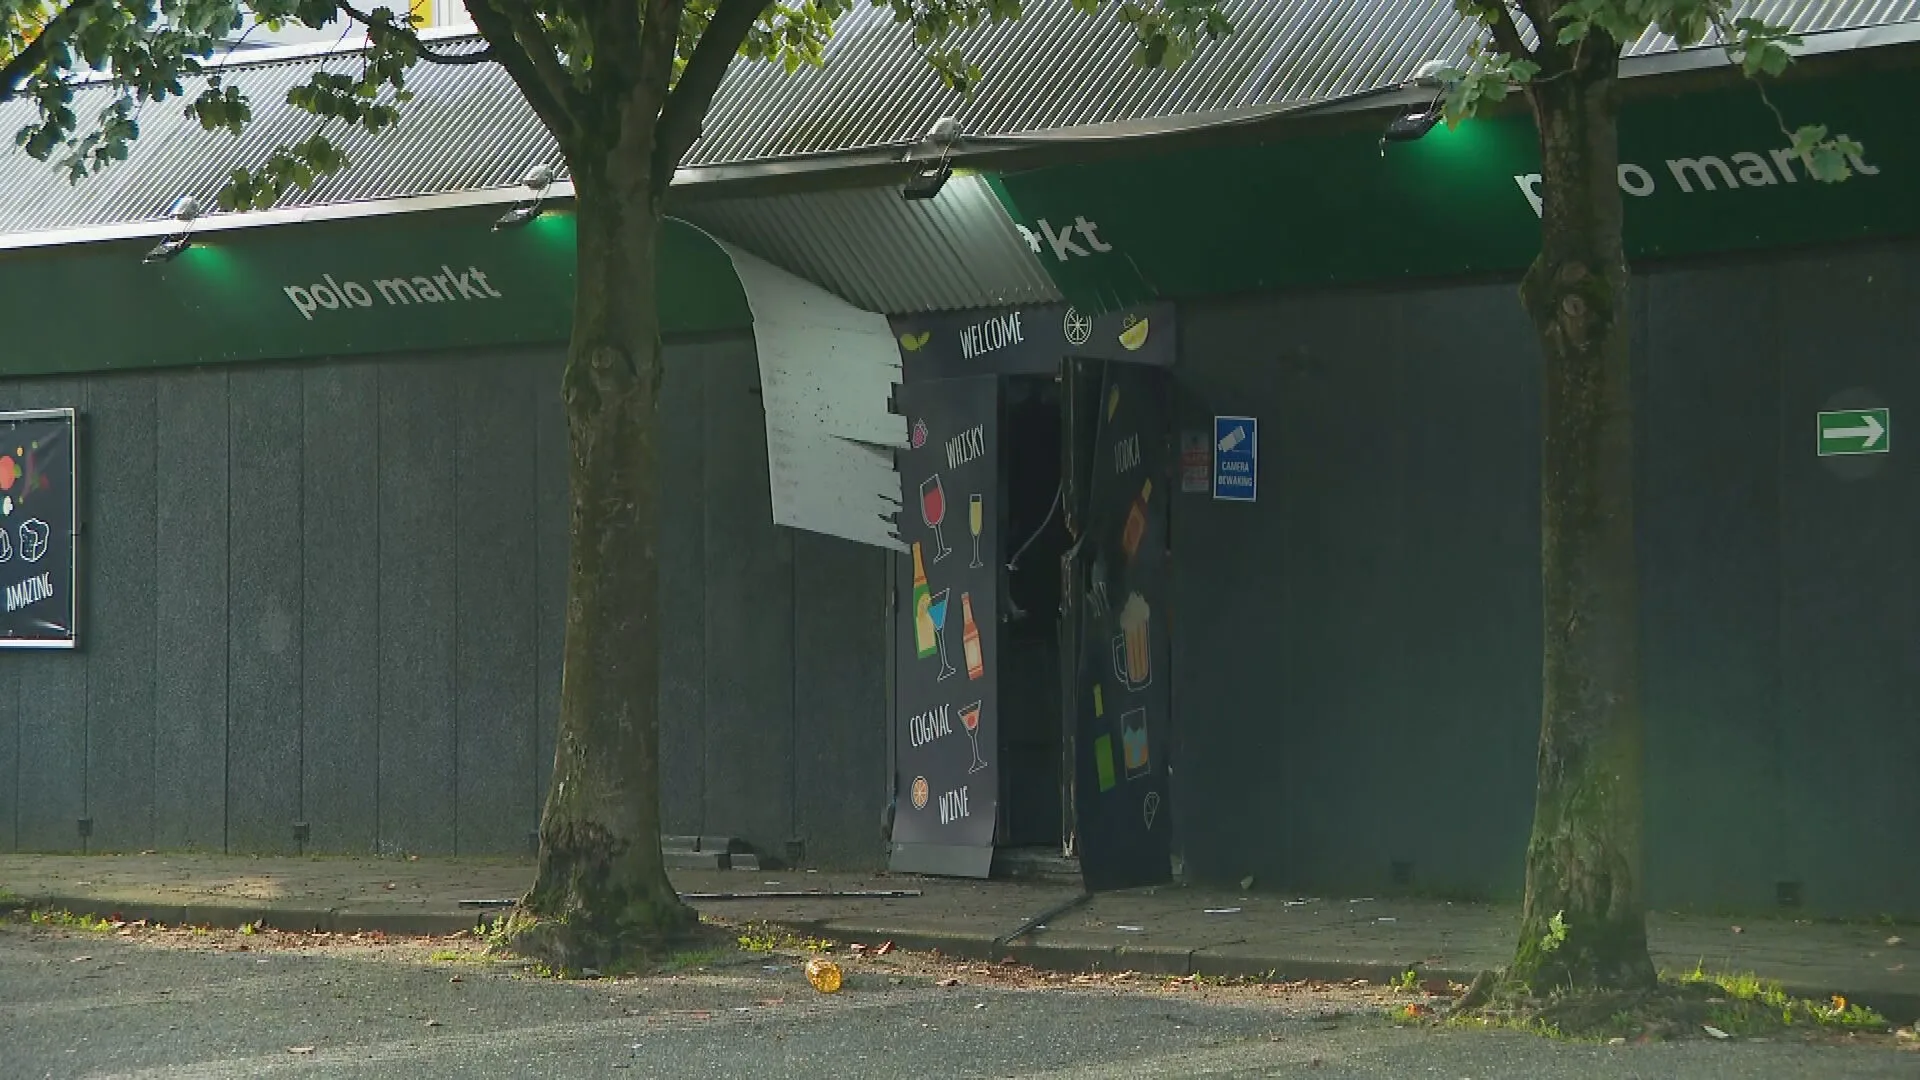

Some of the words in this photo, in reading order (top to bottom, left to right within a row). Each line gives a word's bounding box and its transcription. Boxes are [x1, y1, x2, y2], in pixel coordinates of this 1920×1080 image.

[1513, 163, 1656, 219] po
[283, 273, 374, 321] polo
[372, 264, 502, 305] markt
[959, 311, 1025, 360] WELCOME
[945, 423, 986, 471] WHISKY
[1114, 432, 1141, 474] VODKA
[1221, 461, 1250, 473] CAMERA
[6, 571, 54, 612] AMAZING
[909, 703, 953, 747] COGNAC
[938, 785, 970, 825] WINE
